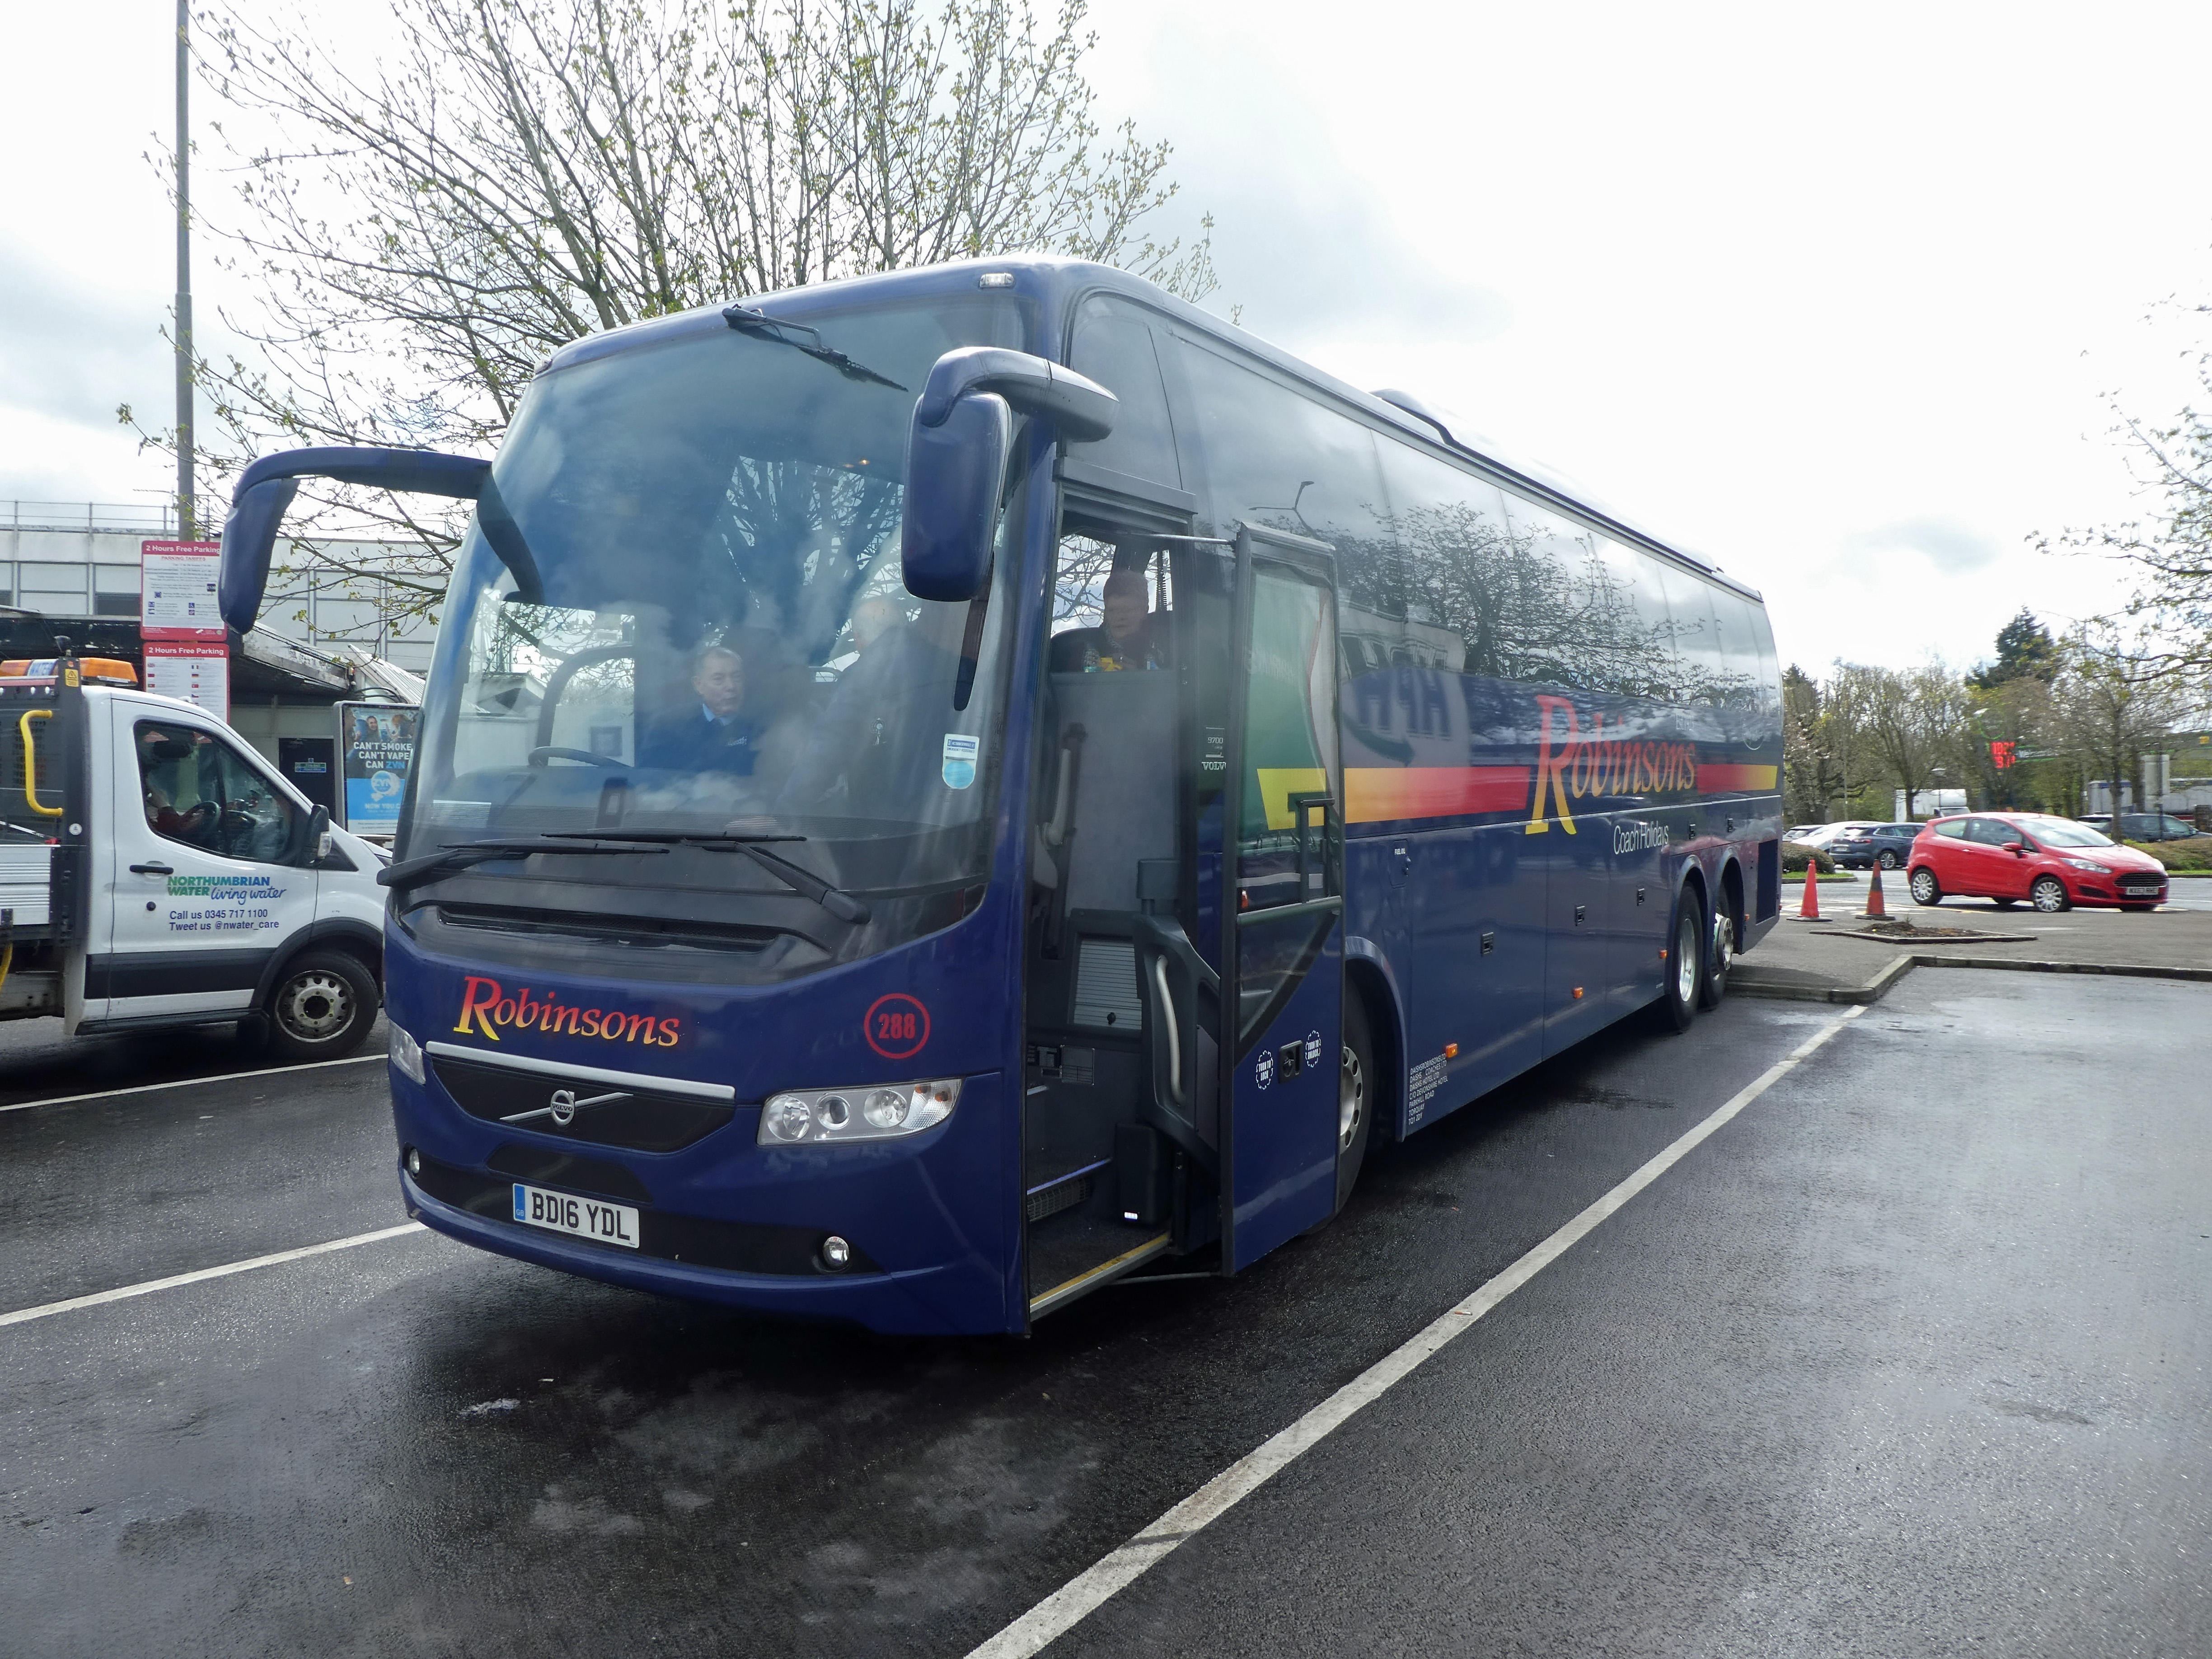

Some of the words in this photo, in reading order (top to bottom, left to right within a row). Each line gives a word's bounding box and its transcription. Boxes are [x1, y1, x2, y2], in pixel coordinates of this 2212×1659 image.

[353, 741, 380, 750] CAN'T
[381, 743, 412, 751] SMOKE
[359, 751, 385, 759] CAN'T
[387, 752, 410, 760] VAPE
[366, 760, 384, 769] CAN
[1525, 694, 1695, 835] Robinsons
[1613, 823, 1639, 855] Coach
[1640, 820, 1669, 852] Holidays
[167, 876, 271, 886] NORTHUMBRIAN
[167, 886, 210, 896] WATER
[210, 887, 248, 905] living
[249, 886, 287, 900] water
[169, 910, 188, 919] Call
[204, 910, 226, 919] 0345
[229, 909, 244, 918] 717
[248, 909, 268, 918] 1100
[169, 922, 198, 931] Tweet
[215, 920, 280, 930] @nwater_care
[453, 976, 680, 1046] Robinsons
[1425, 1090, 1434, 1100] ROAD
[552, 1103, 573, 1111] VOLVO
[532, 1192, 579, 1229] BD16
[586, 1204, 630, 1241] YDL
